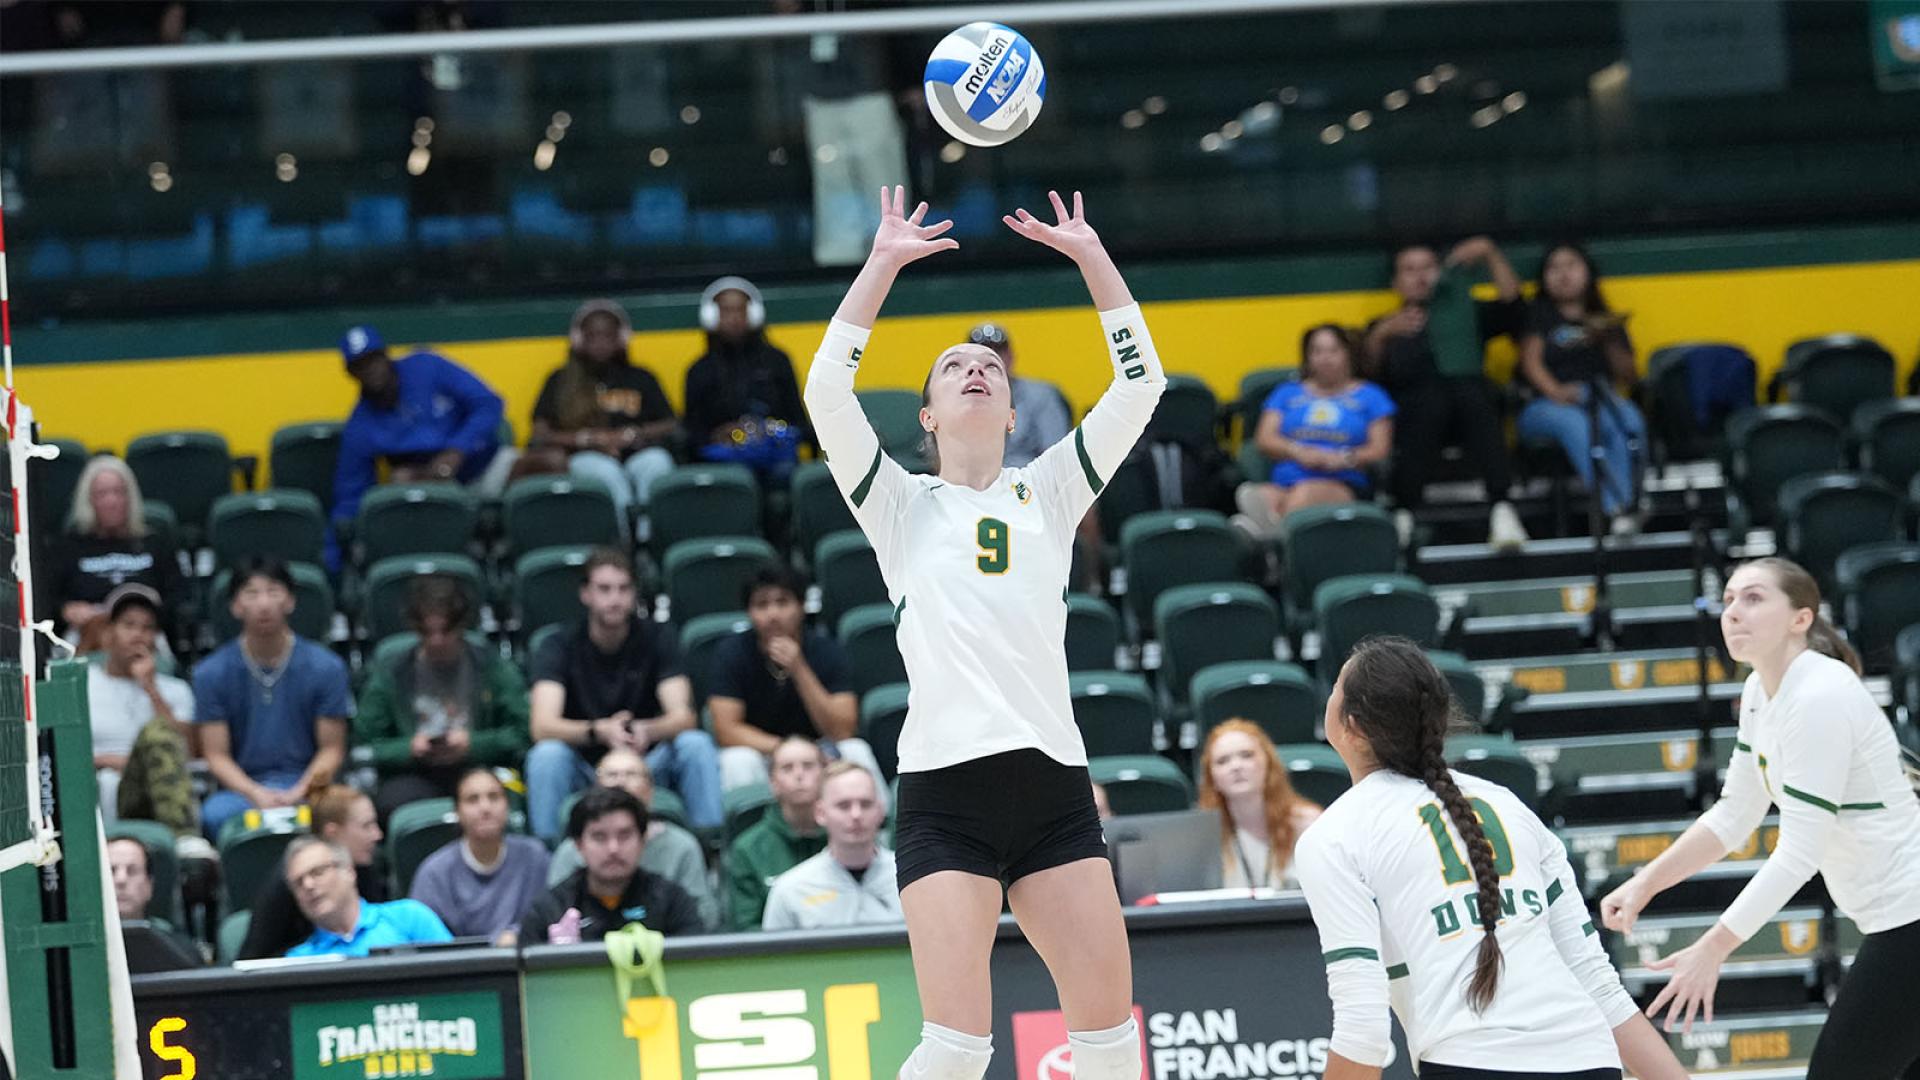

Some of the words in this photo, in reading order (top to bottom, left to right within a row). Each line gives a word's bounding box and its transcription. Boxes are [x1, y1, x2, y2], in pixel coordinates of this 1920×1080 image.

[965, 37, 1008, 95] molten
[986, 49, 1025, 105] NCAA
[1112, 325, 1151, 384] ONS
[976, 516, 1011, 576] 9
[373, 1003, 419, 1026] SAN
[1149, 1008, 1238, 1048] SAN
[317, 1017, 477, 1067] FRANCISCO
[1152, 1037, 1397, 1080] FRANCIS
